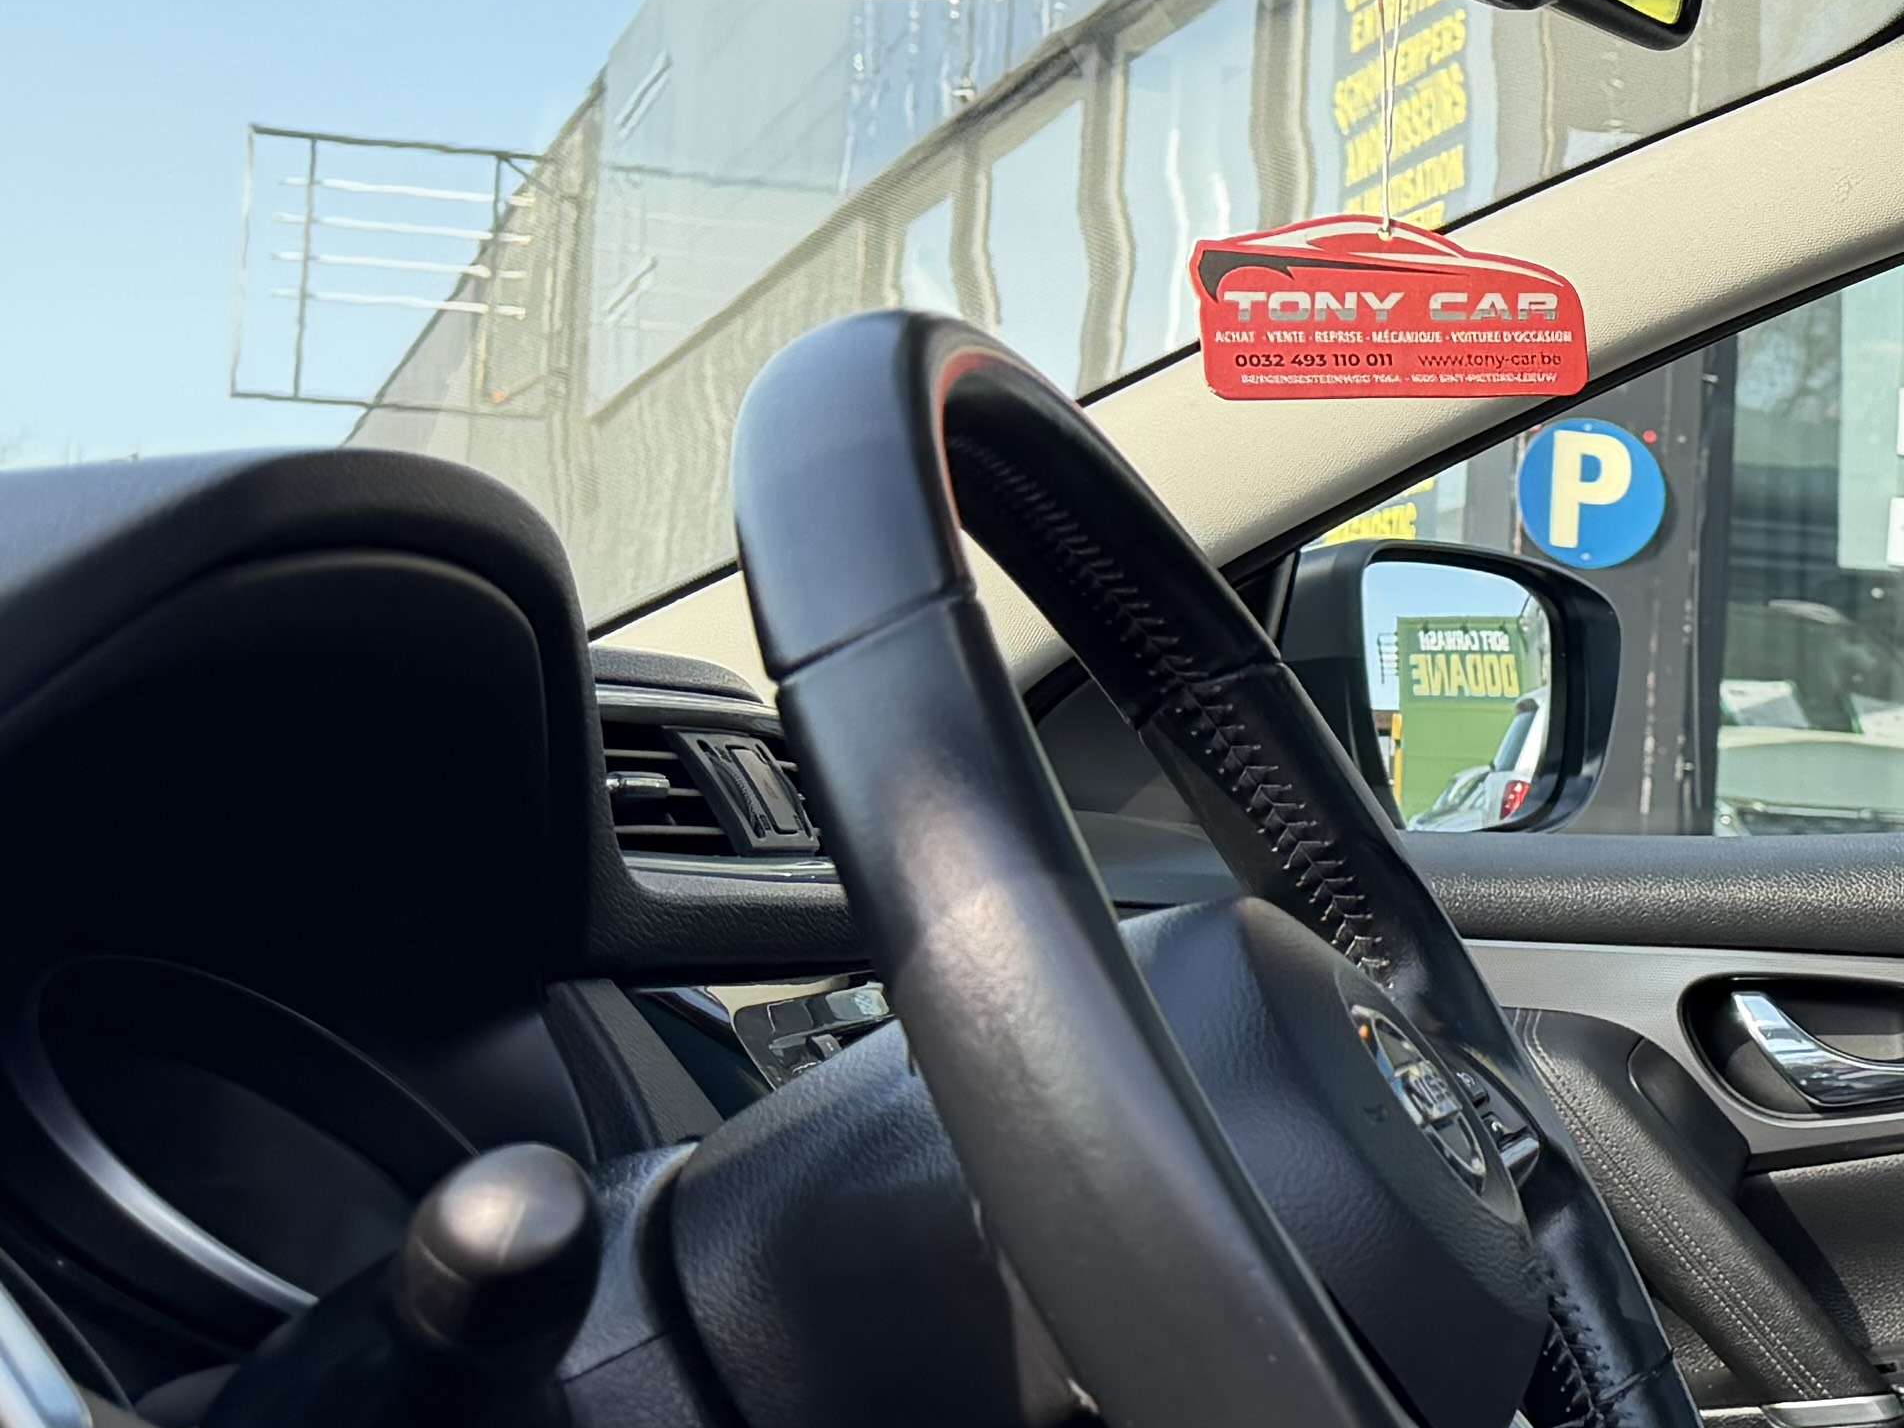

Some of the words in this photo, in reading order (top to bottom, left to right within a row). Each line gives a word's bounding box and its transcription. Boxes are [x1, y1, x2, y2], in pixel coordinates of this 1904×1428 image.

[1224, 291, 1405, 322] TONY
[1429, 292, 1559, 322] CAR
[1215, 330, 1255, 343] ACHAT
[1267, 330, 1306, 343] VENTE
[1314, 330, 1364, 343] REPRISE
[1235, 353, 1285, 368] 0032
[1290, 353, 1328, 368] 493
[1333, 353, 1361, 368] 110
[1366, 353, 1394, 368] 011
[1418, 351, 1562, 369] www.tony-car.be
[1549, 429, 1632, 548] P
